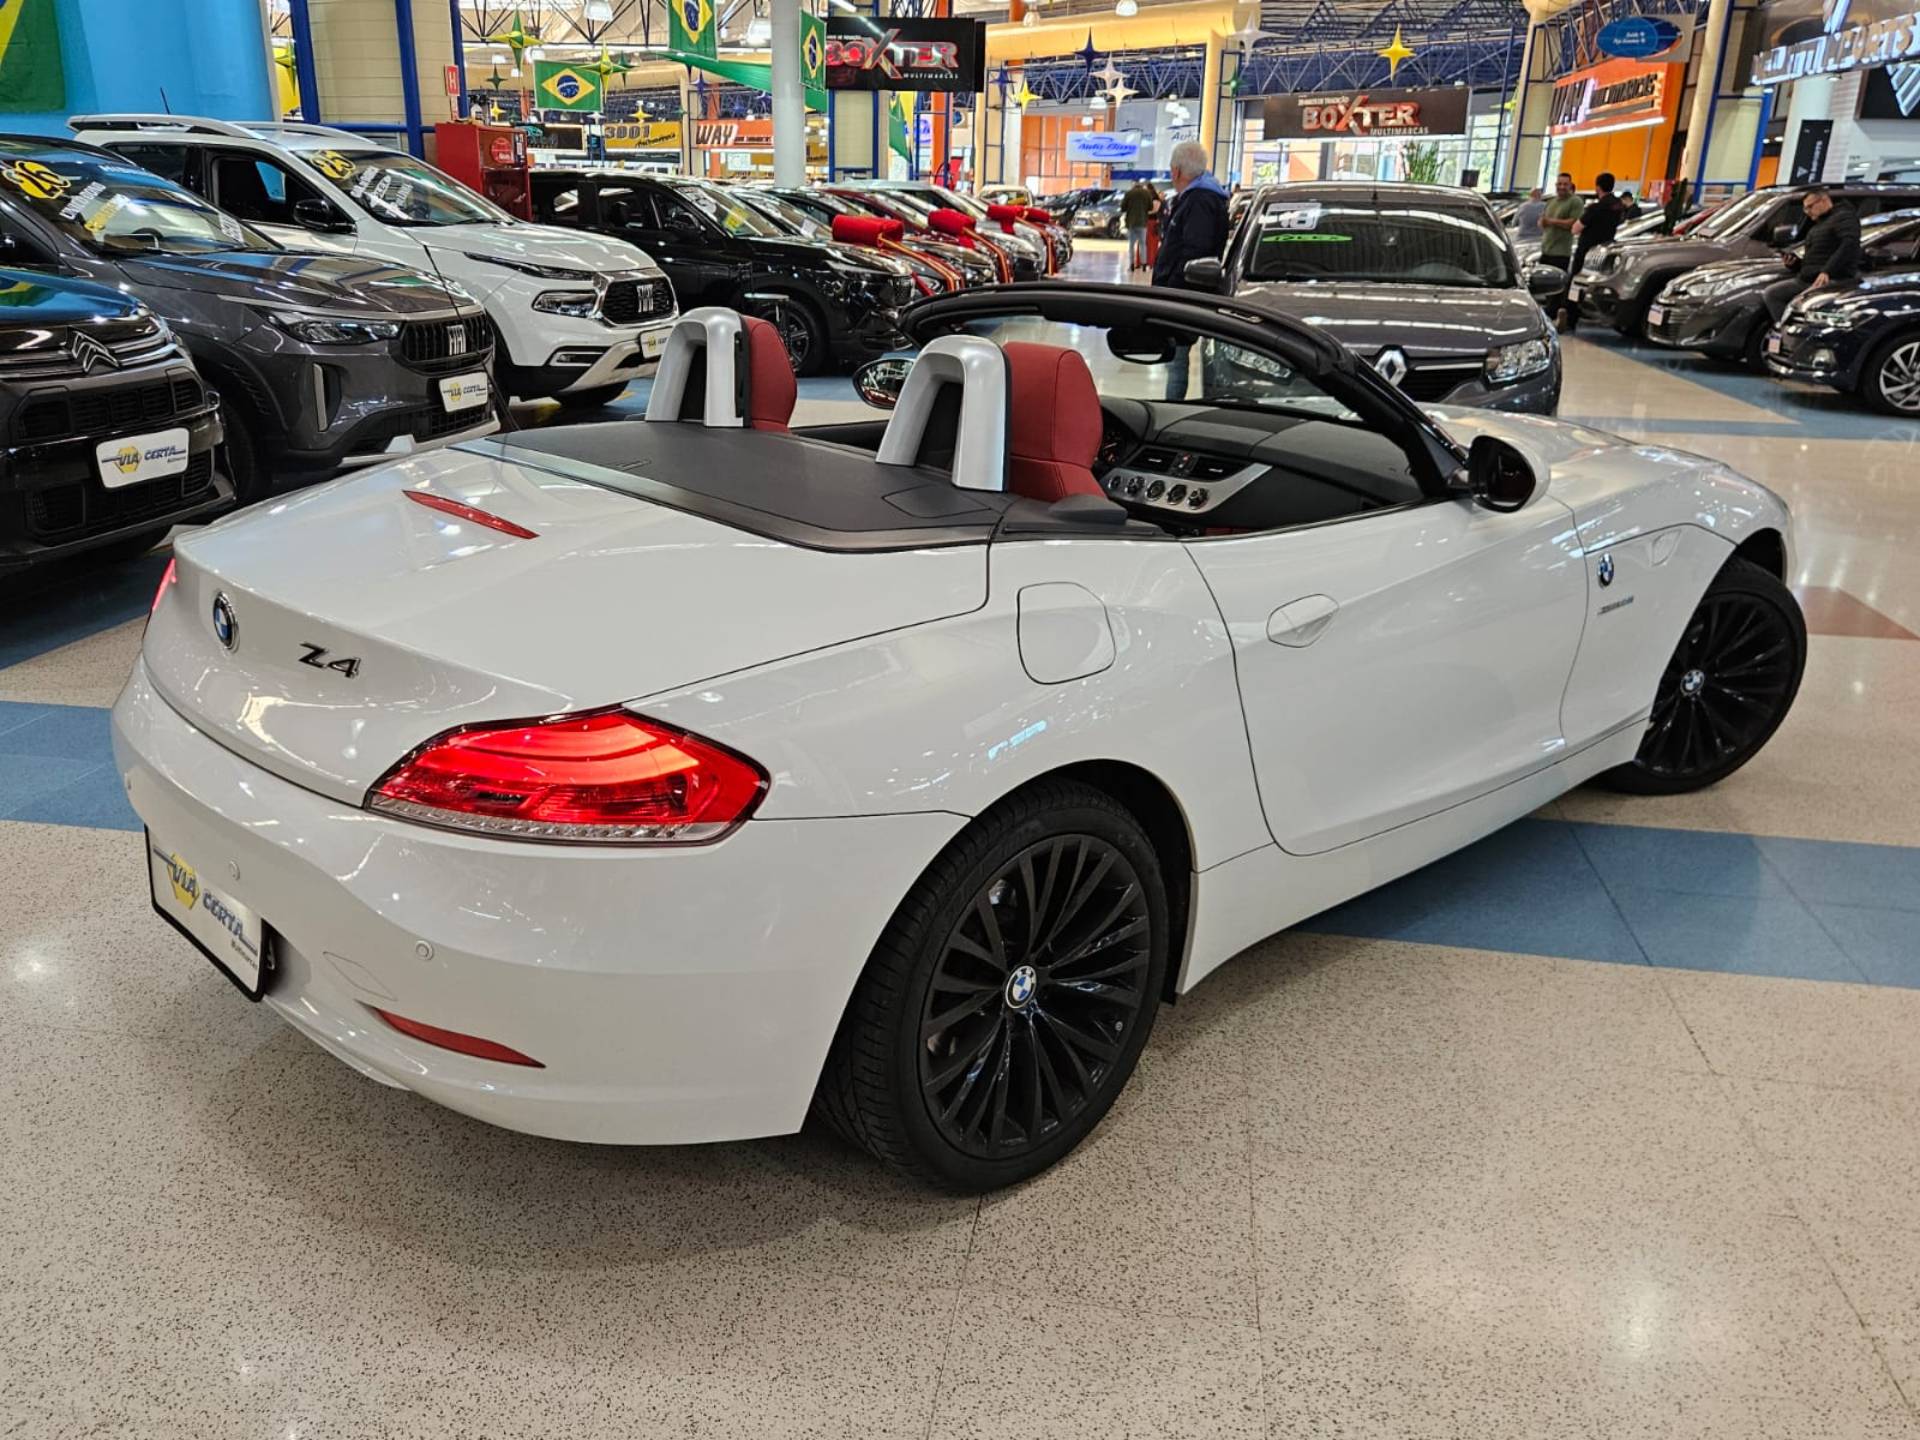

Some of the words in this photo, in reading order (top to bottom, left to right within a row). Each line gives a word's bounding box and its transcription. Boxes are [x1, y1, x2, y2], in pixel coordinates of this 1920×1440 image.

[825, 28, 959, 79] BOXTER
[604, 125, 650, 140] 3001
[695, 124, 736, 146] WAY
[1302, 95, 1420, 136] BOXTER
[1370, 126, 1430, 137] MULTIMARCAS
[3, 160, 70, 199] 26
[119, 450, 140, 467] VIA
[144, 445, 178, 461] CERTA
[298, 640, 361, 679] Z4
[172, 863, 198, 899] VIA
[202, 892, 245, 939] CERTA
